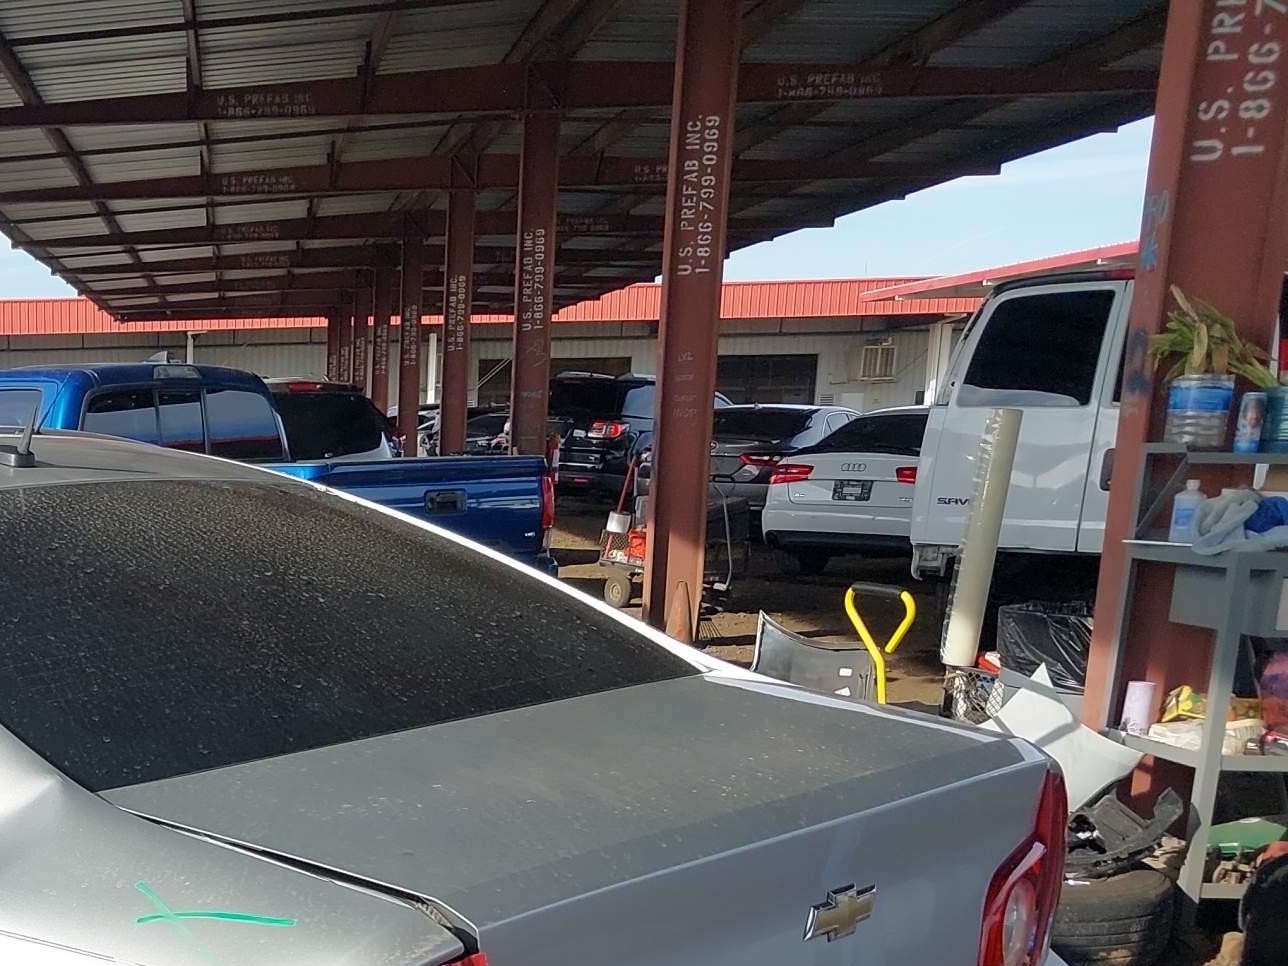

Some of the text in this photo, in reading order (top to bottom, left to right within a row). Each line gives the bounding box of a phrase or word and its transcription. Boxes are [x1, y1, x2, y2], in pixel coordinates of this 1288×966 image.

[1190, 0, 1247, 161] U.S. PR
[677, 114, 702, 276] U.S. PREFAB INC.
[695, 115, 721, 274] 1-866-799-0969
[521, 308, 533, 331] U.S.
[522, 257, 533, 302] PREFAB
[533, 228, 545, 329] 1-866-799-0969
[936, 496, 969, 505] SAV
